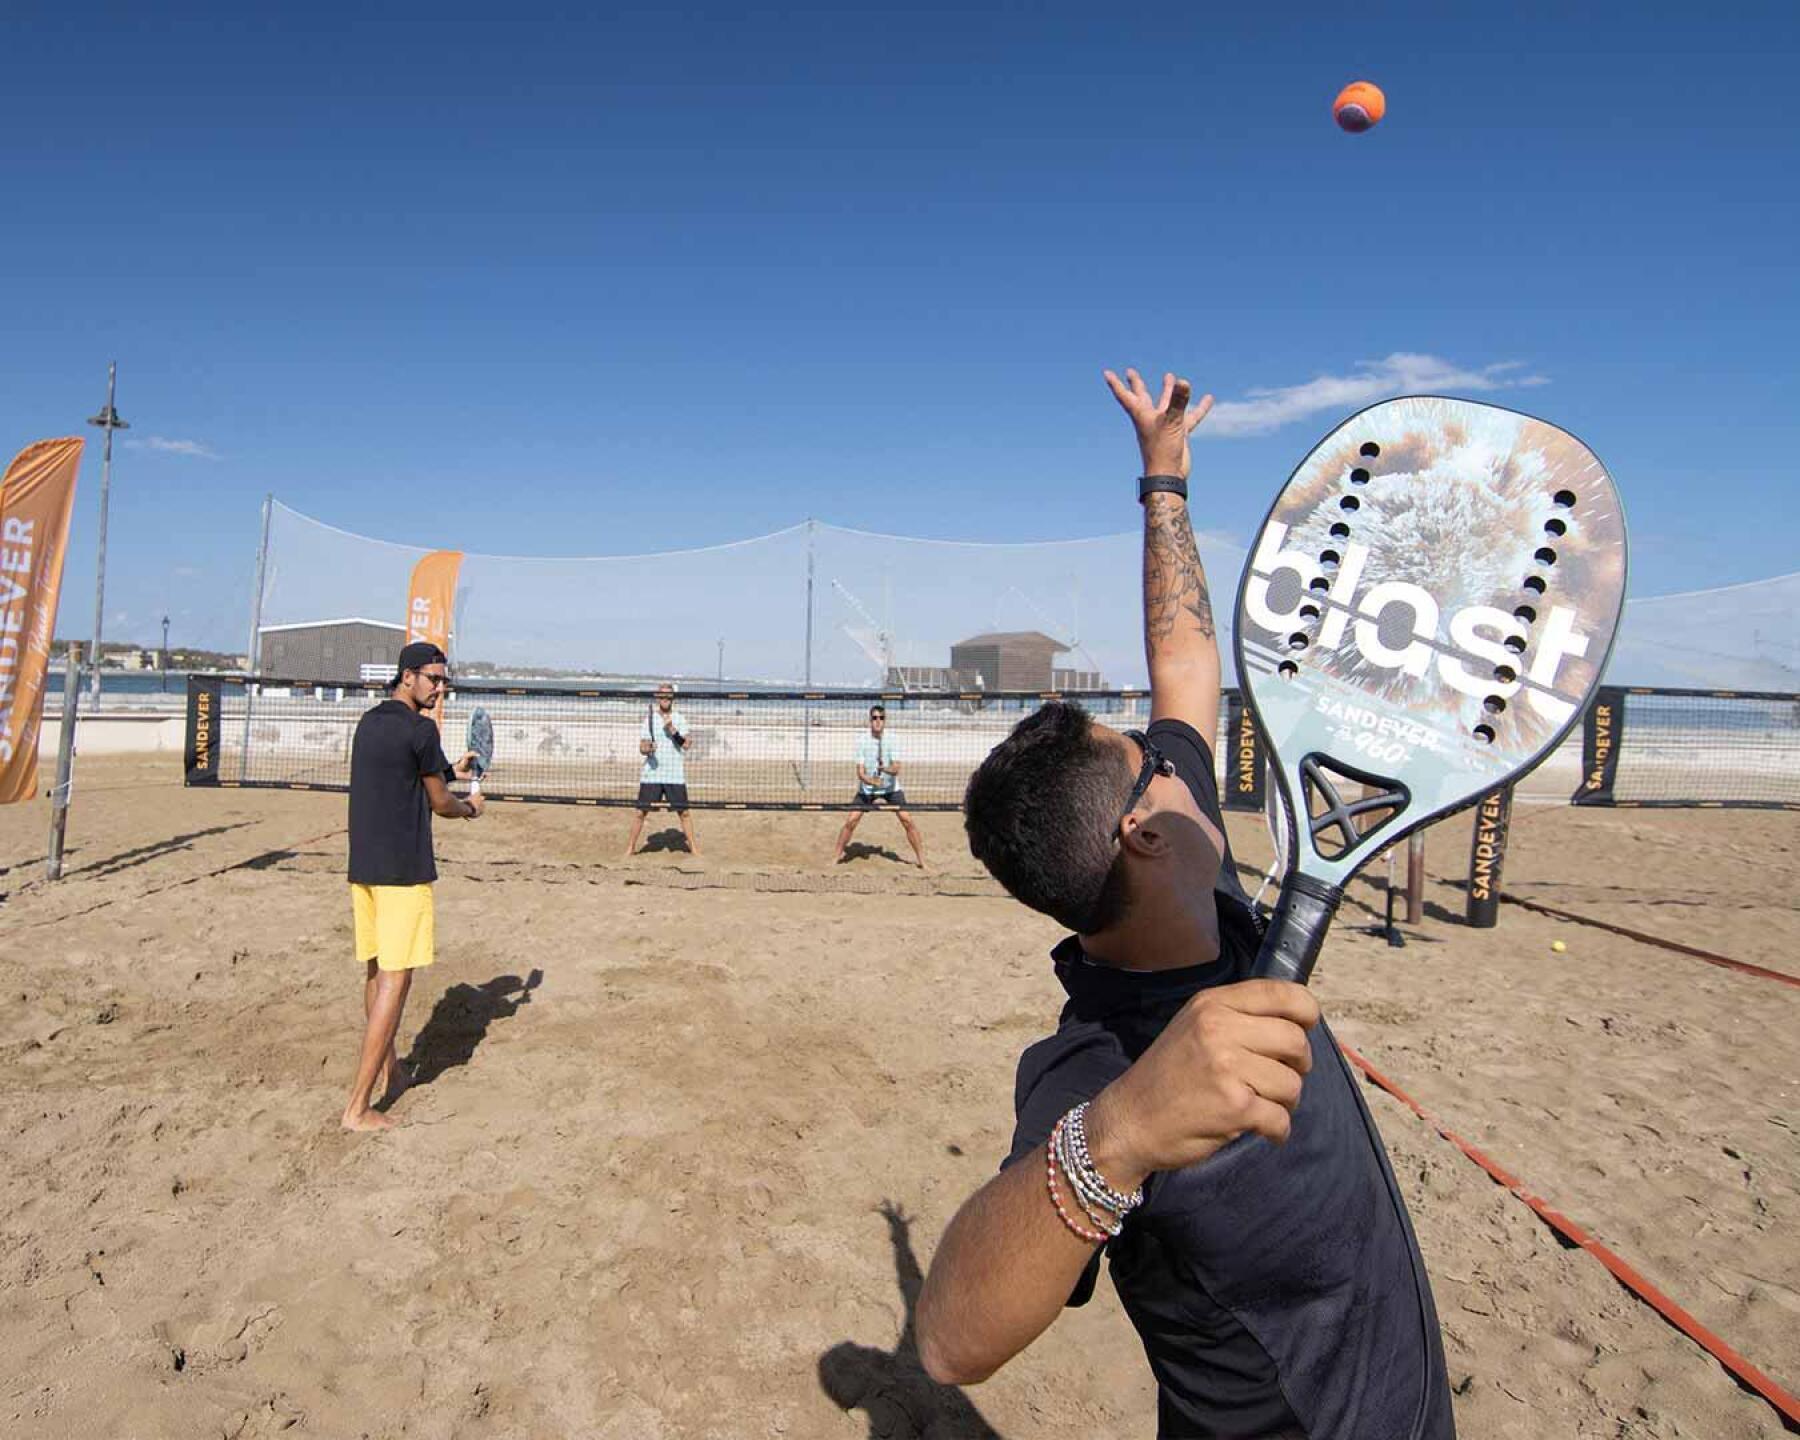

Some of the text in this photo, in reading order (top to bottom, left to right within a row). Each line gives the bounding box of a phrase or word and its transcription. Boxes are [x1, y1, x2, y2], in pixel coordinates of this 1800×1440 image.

[1245, 520, 1590, 725] blast
[195, 692, 209, 769] SANDEVER
[1316, 695, 1442, 751] SANDEVER
